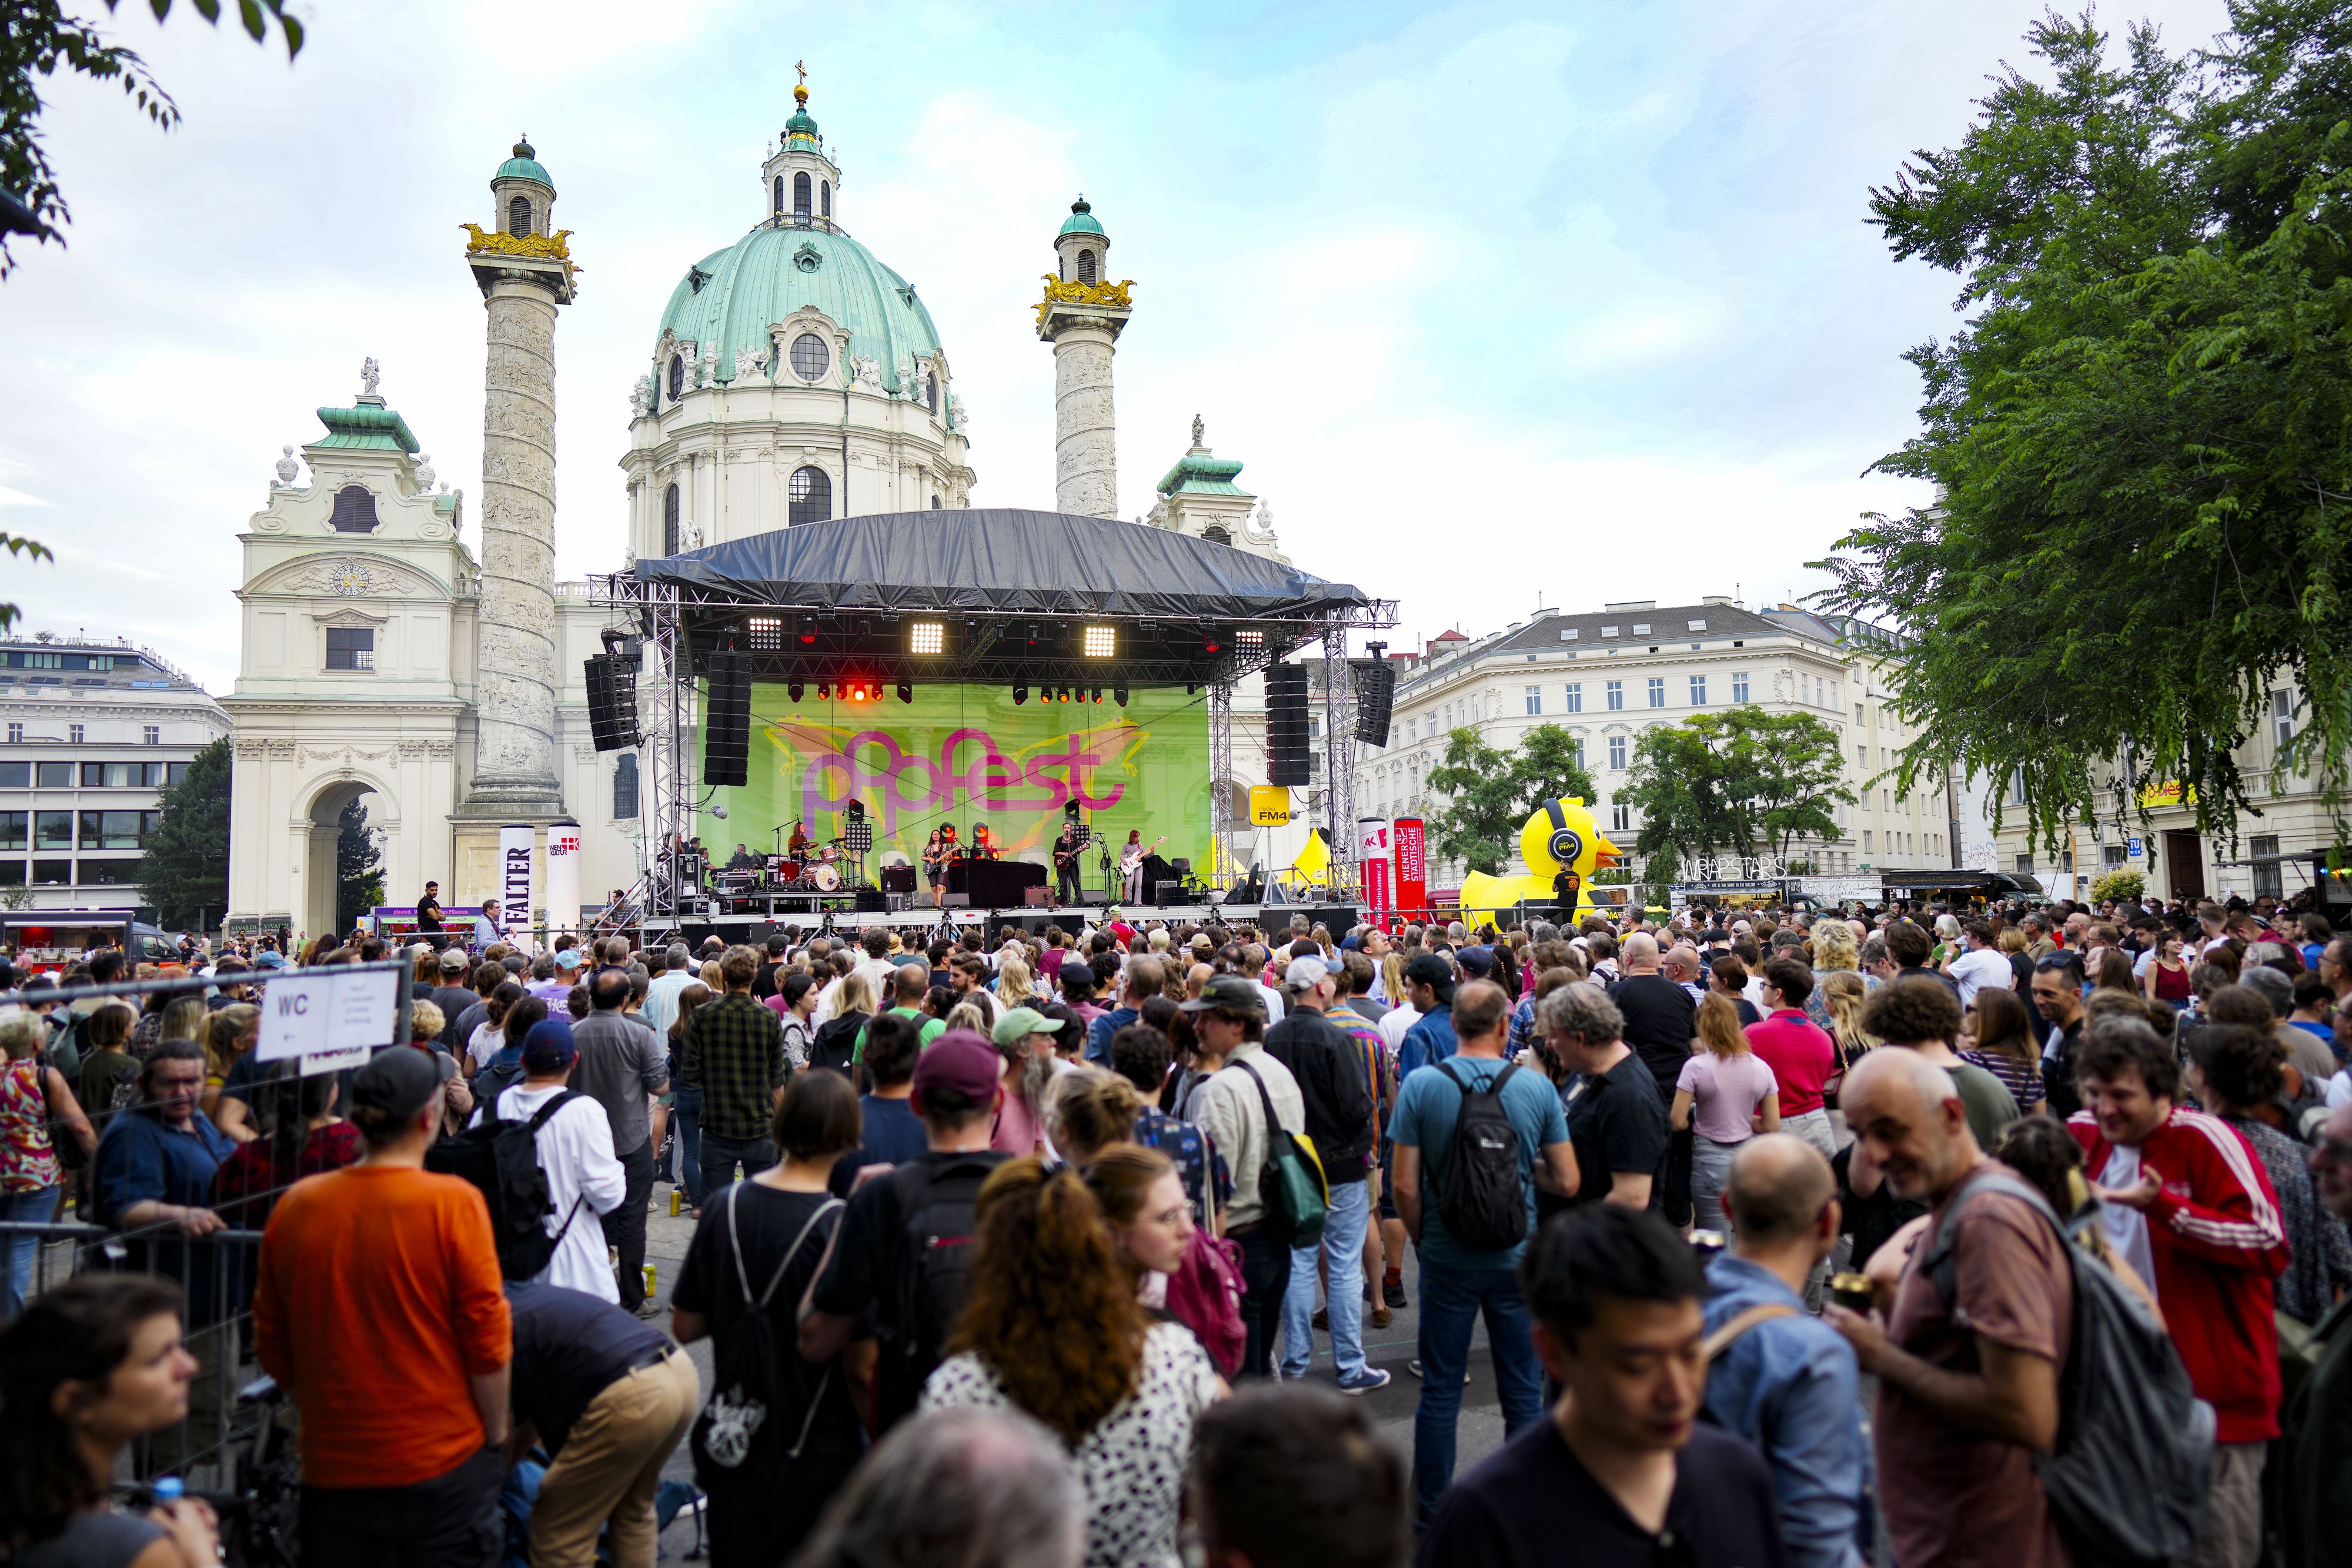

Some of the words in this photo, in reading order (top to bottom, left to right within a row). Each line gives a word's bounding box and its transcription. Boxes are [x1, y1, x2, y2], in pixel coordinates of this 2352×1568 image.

[803, 727, 1125, 840] popfest
[1259, 811, 1287, 820] FM4
[1364, 836, 1377, 848] AK
[1408, 827, 1418, 881] STÄDTISCHE
[1559, 842, 1575, 851] FM4
[2129, 840, 2140, 849] TU
[1401, 844, 1410, 882] WIENER
[1682, 855, 1786, 881] WRAPSTARS
[505, 848, 530, 924] FALTER
[1435, 881, 1463, 890] COFF
[278, 993, 308, 1017] WC
